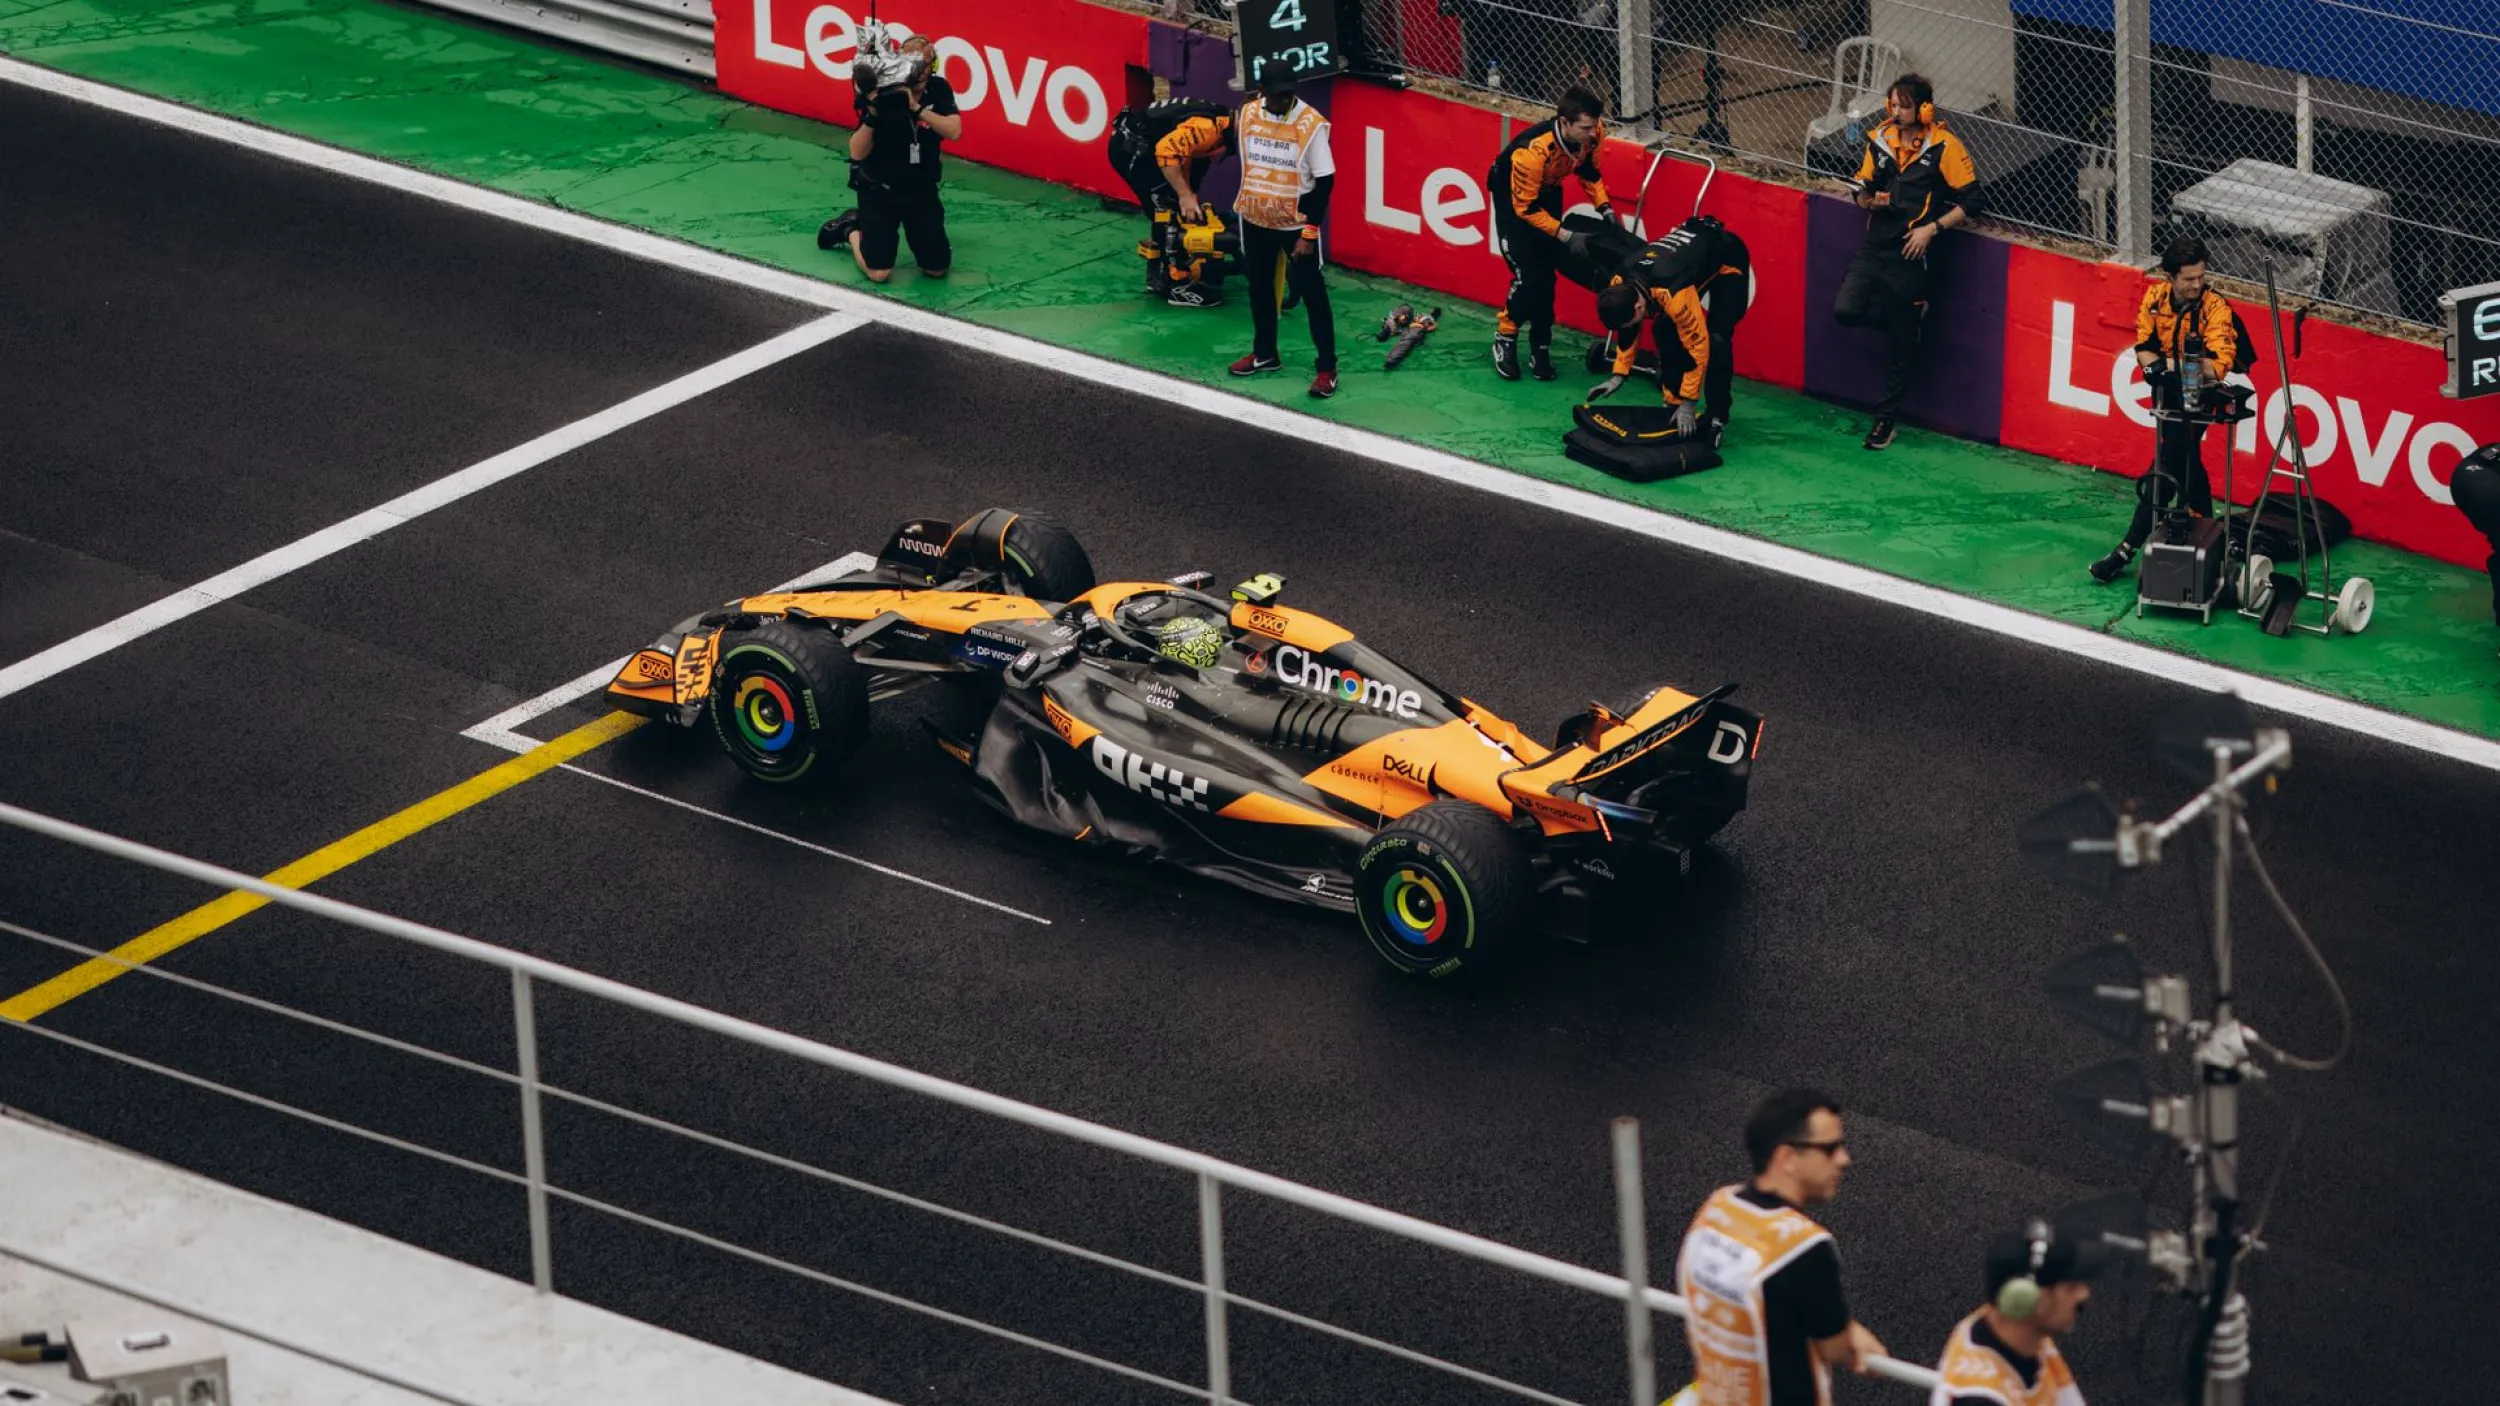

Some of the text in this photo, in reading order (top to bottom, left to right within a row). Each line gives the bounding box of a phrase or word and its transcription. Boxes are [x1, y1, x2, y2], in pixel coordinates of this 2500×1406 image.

[1268, 0, 1307, 31] 4
[1249, 610, 1288, 635] OXXO
[970, 625, 1028, 648] RICHARD MILLE
[977, 644, 992, 658] DP
[992, 648, 1016, 662] WOR
[639, 656, 673, 682] OXXO
[1275, 645, 1422, 718] Chrome
[1383, 754, 1426, 784] DELL
